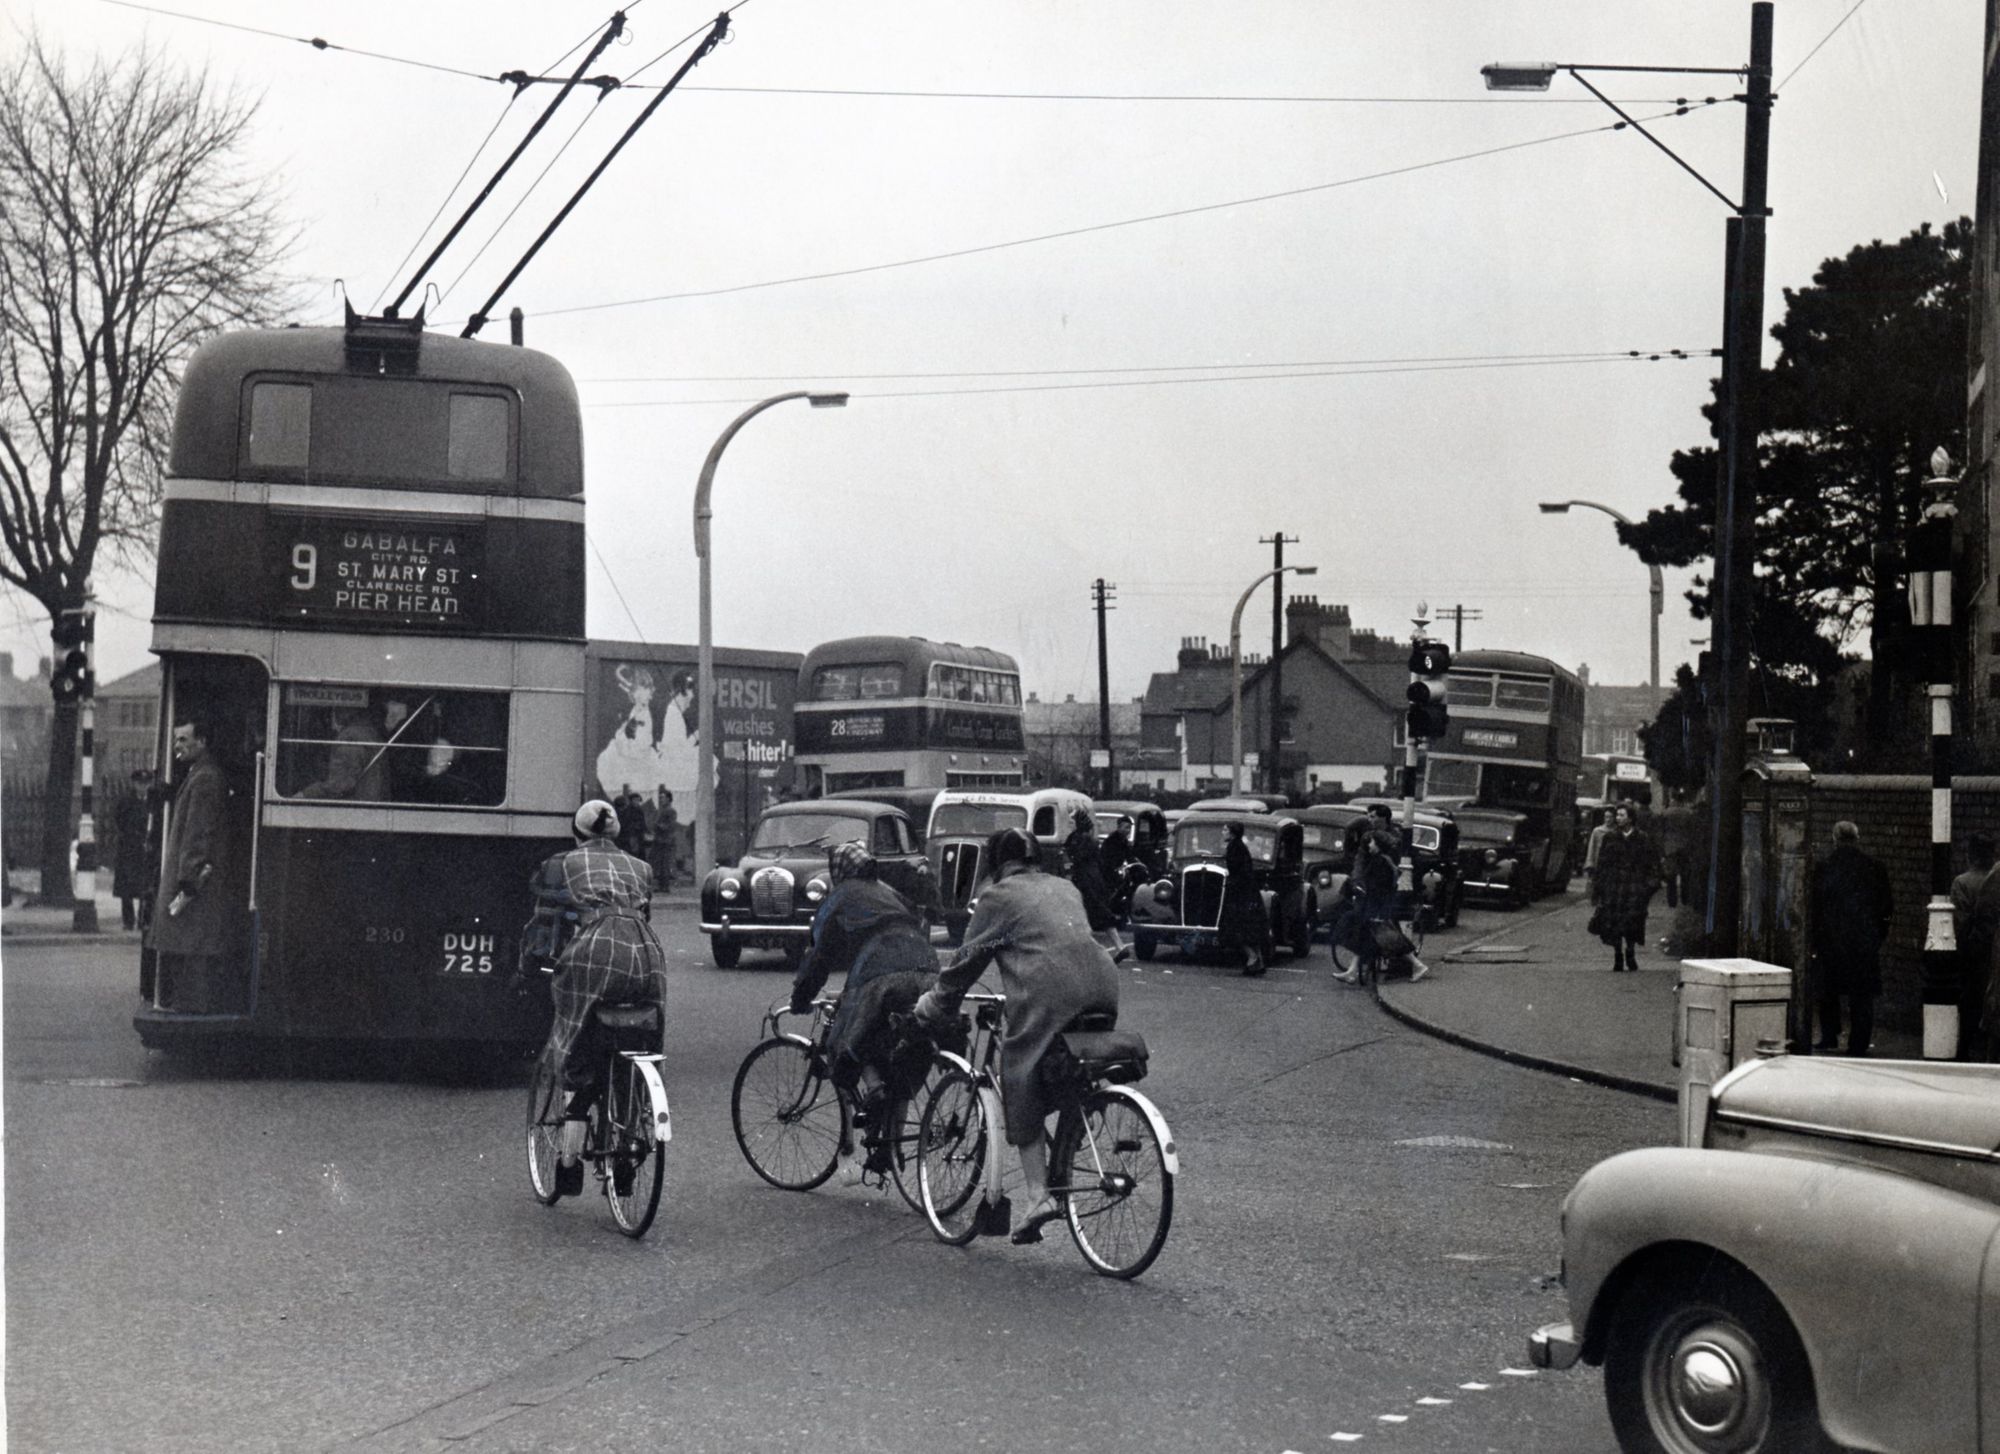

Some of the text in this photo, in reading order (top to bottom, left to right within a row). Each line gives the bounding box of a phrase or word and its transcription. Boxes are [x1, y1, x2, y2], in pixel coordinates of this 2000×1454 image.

[344, 531, 456, 554] GABALFA
[291, 543, 317, 590] 9
[371, 552, 431, 565] CITY RD.
[372, 564, 427, 581] MARY
[346, 580, 424, 593] CLARENCE
[336, 590, 458, 614] PIER HEAD
[723, 713, 775, 736] washes
[831, 719, 846, 736] 28
[365, 926, 405, 944] 230
[443, 933, 494, 952] DUH
[443, 954, 493, 973] 725
